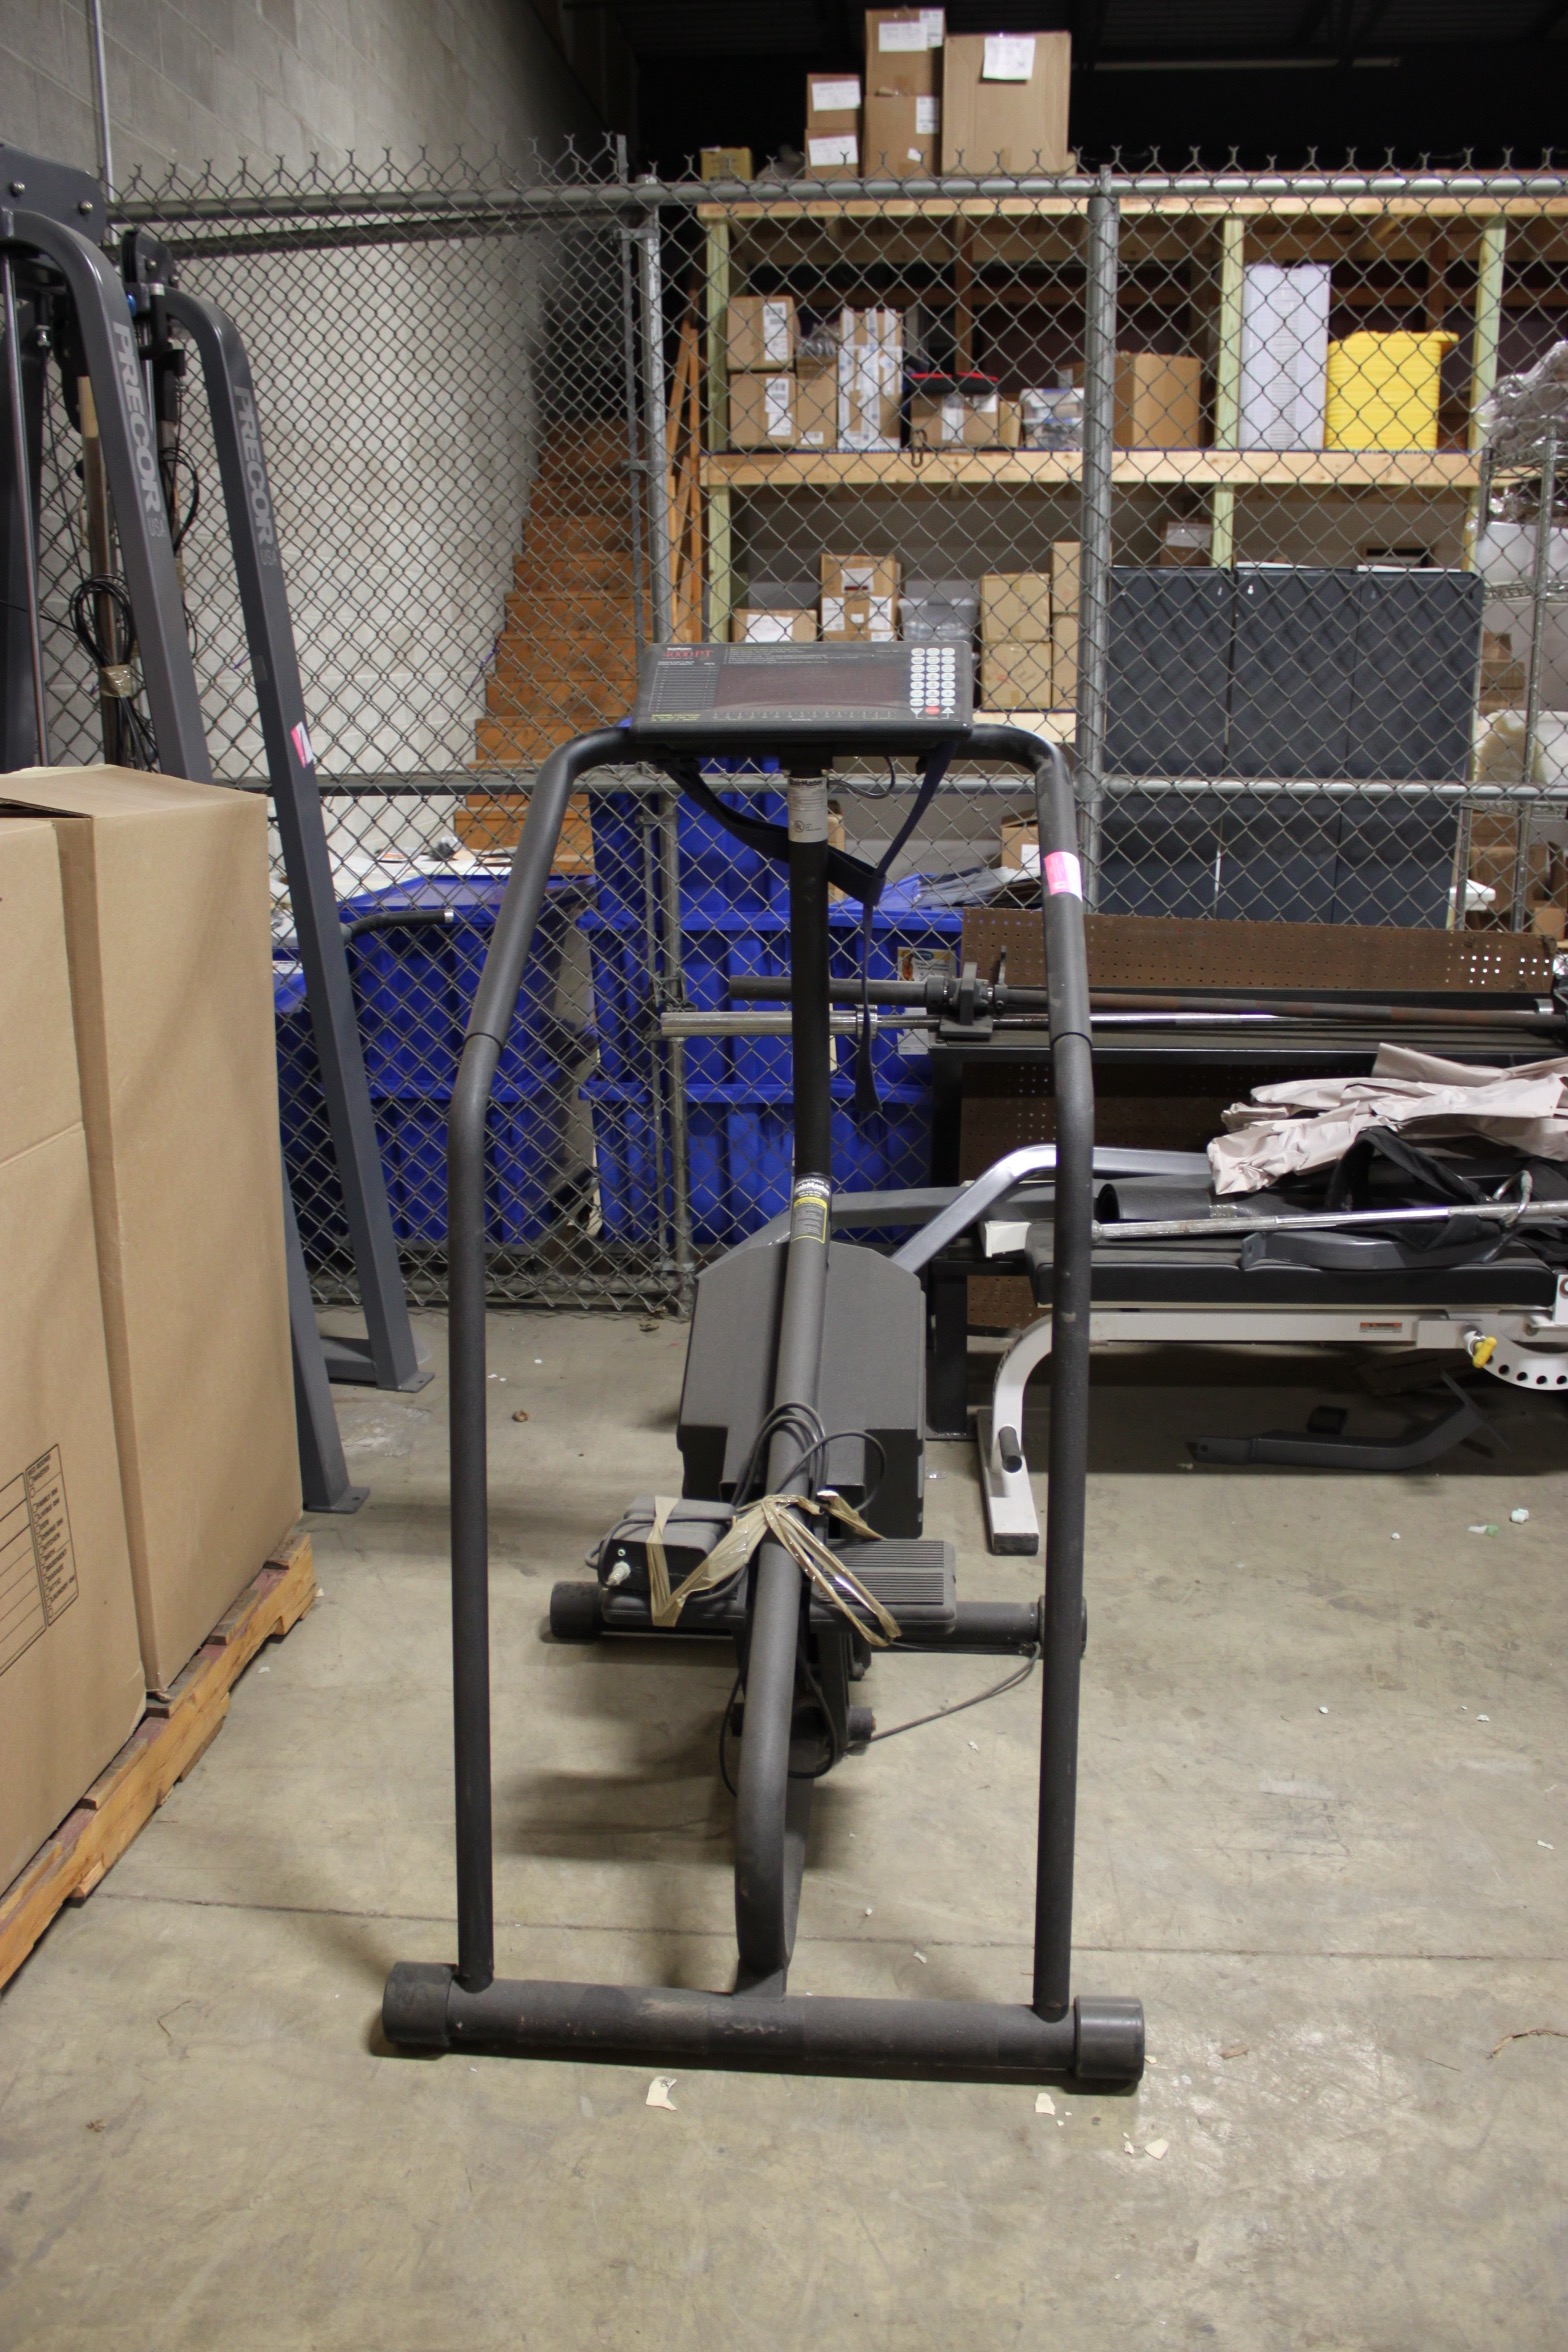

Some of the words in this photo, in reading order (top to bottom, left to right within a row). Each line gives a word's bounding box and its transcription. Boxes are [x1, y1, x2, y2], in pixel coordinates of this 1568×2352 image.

[113, 321, 161, 513] PRECOR
[147, 516, 167, 539] USA
[234, 385, 274, 545] PRECOR
[260, 549, 278, 567] USA
